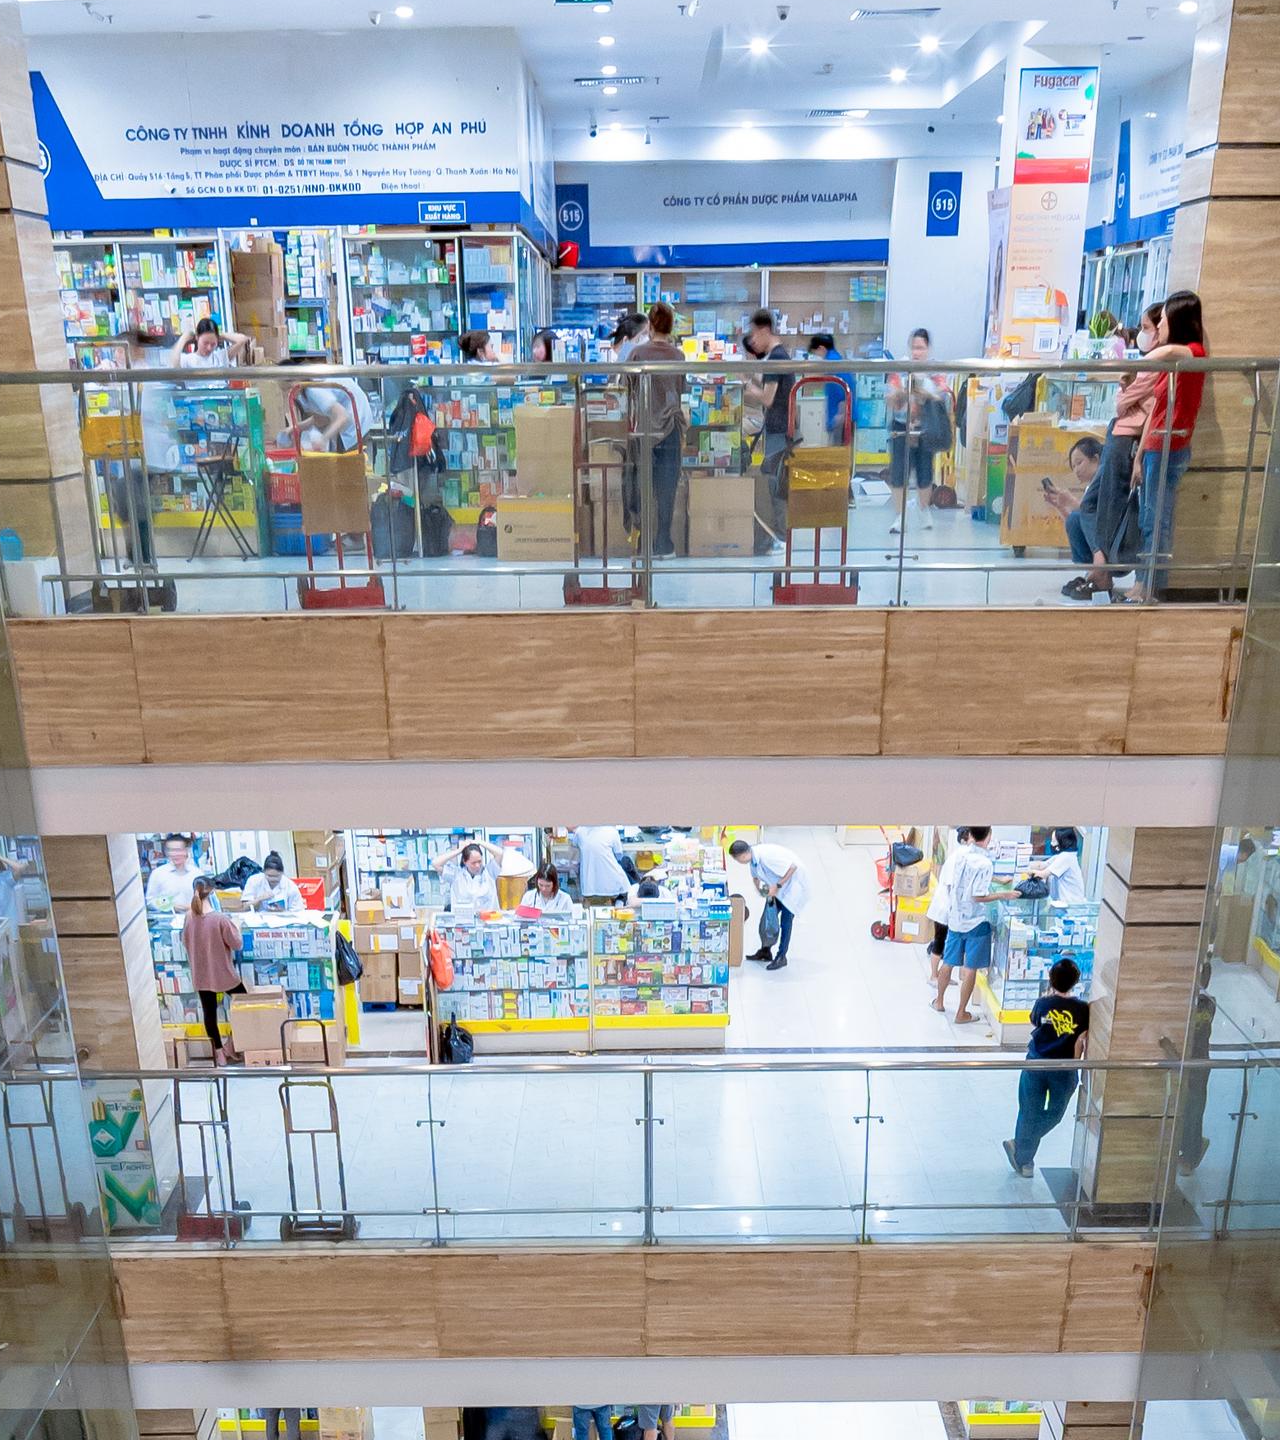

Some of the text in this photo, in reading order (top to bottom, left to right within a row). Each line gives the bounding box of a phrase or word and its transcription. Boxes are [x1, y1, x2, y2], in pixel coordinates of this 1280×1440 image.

[1034, 74, 1083, 89] Fugacar
[125, 125, 170, 141] CÔNG
[174, 127, 188, 140] TY
[192, 126, 228, 140] TNHH
[281, 122, 335, 138] DOANH
[395, 121, 424, 139] HỢP
[432, 122, 452, 135] AN
[460, 118, 487, 135] PHÚ
[180, 147, 202, 156] Phạm
[213, 147, 230, 156] hoạt
[232, 146, 252, 156] động
[255, 145, 282, 155] chuyên
[663, 195, 691, 207] CÔNG
[694, 196, 705, 206] TY
[752, 193, 778, 207] DƯỢC
[811, 192, 858, 204] VALLAPHA
[936, 198, 953, 211] 515
[563, 209, 580, 222] 515
